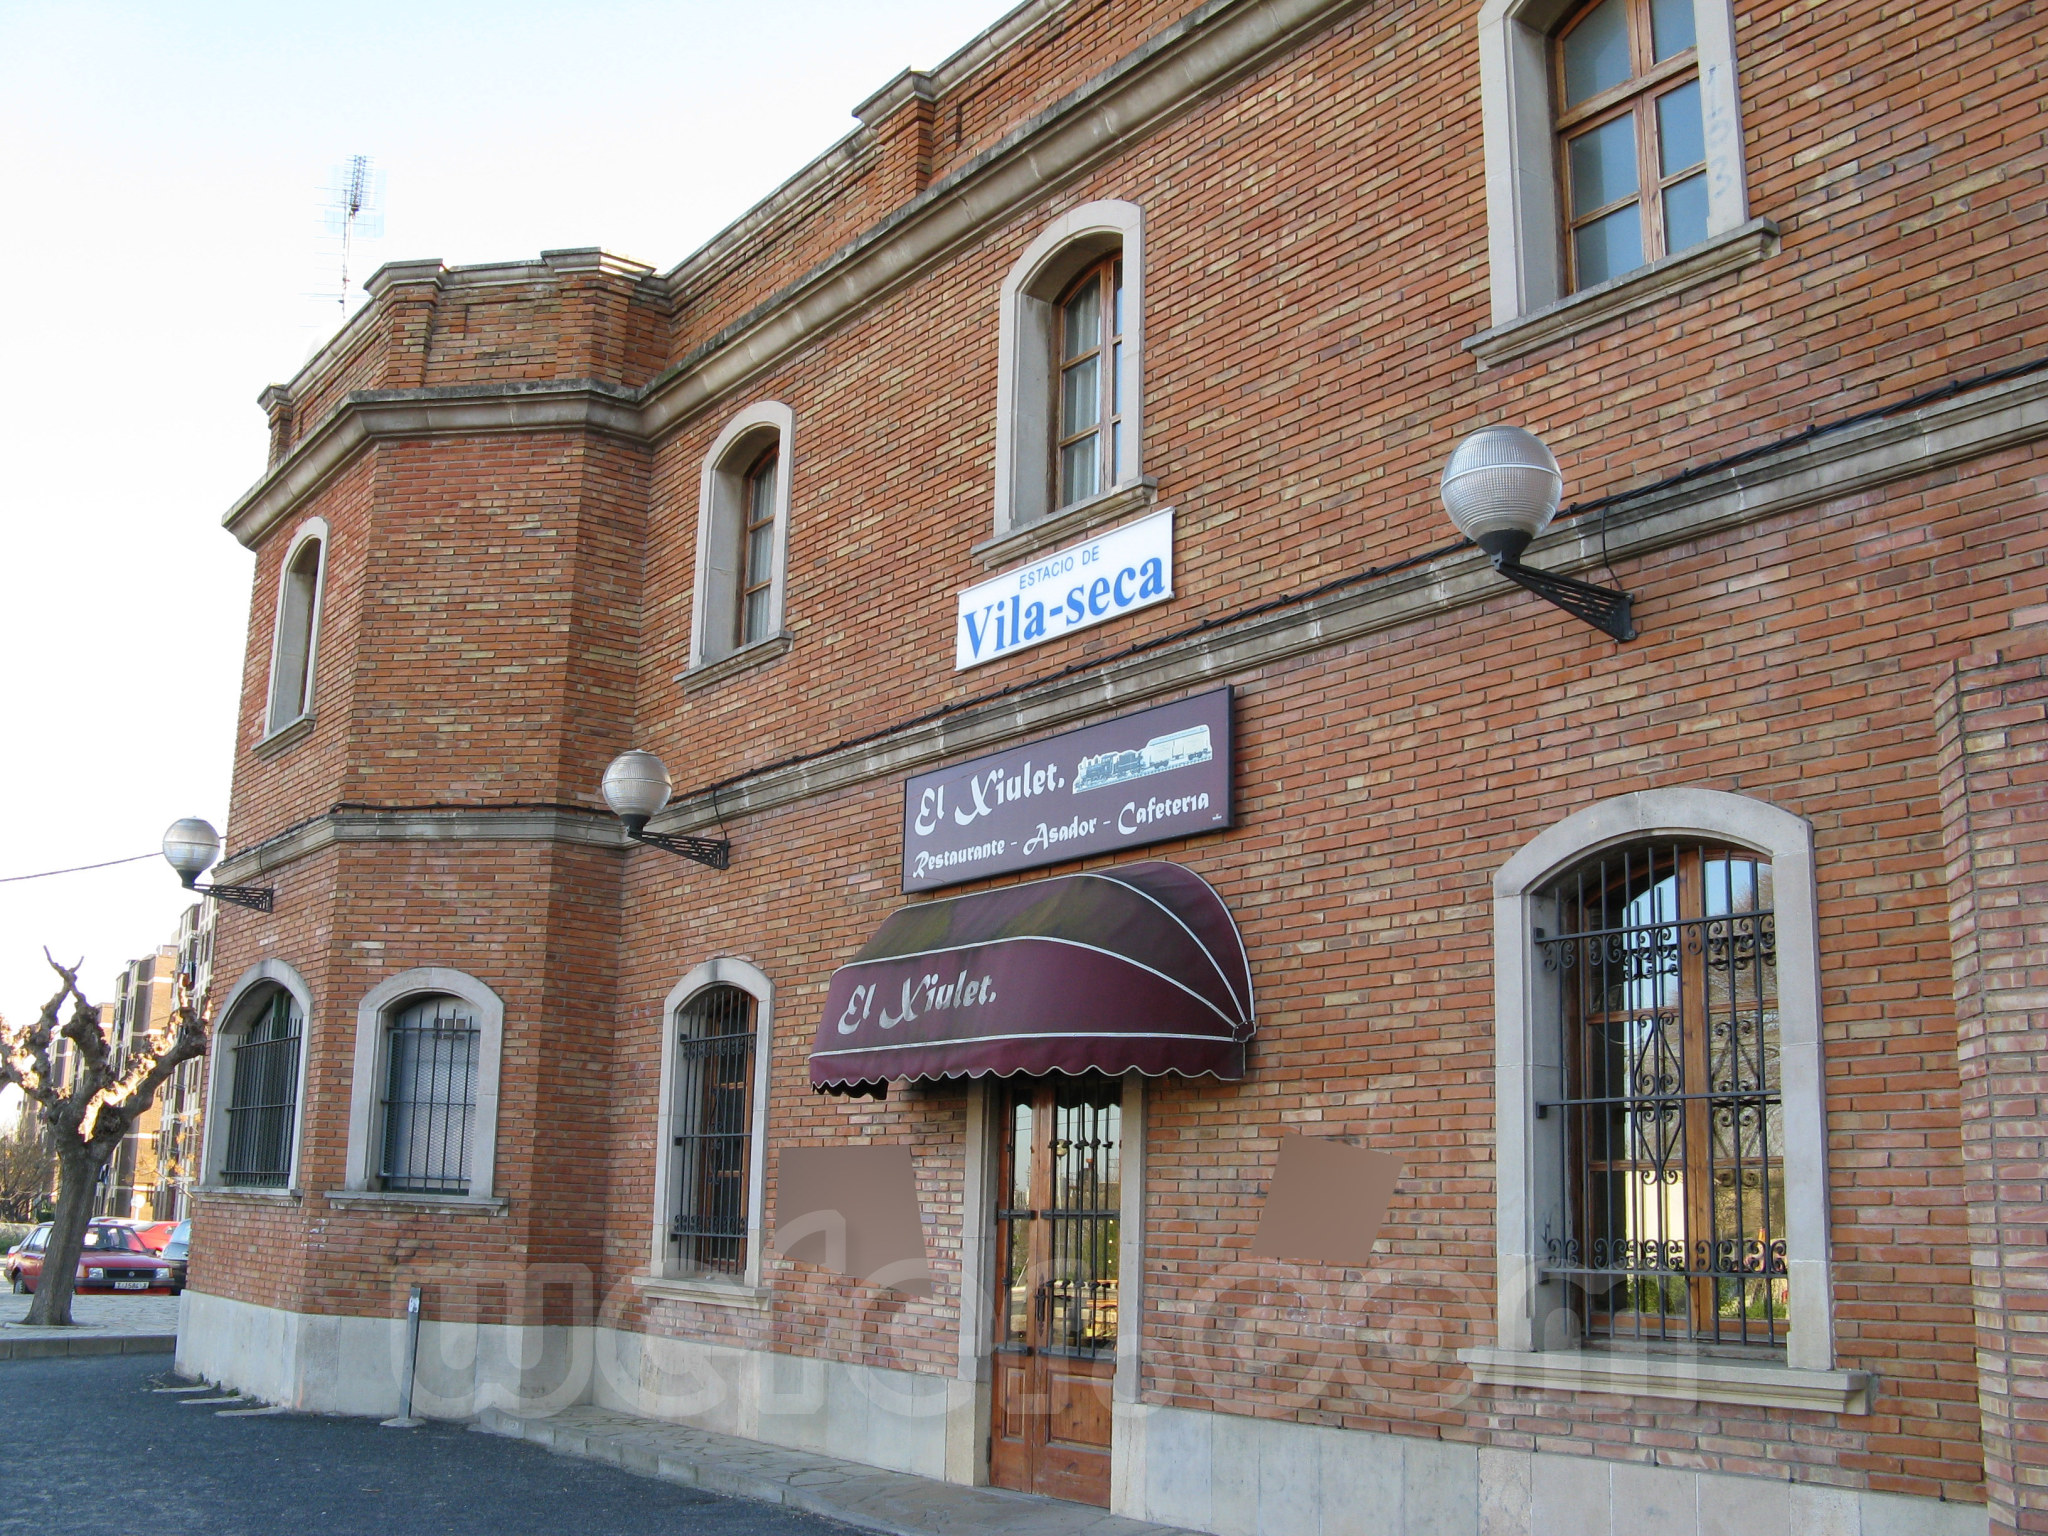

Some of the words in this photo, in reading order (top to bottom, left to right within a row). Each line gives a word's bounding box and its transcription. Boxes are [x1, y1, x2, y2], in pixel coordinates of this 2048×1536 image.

[1019, 556, 1075, 591] ESTACIO
[1082, 545, 1100, 566] DE
[962, 556, 1166, 660] Vila-seca
[914, 784, 945, 837] El
[912, 839, 1007, 880] Restaurante
[1022, 815, 1098, 856] Asador
[837, 983, 877, 1035] El
